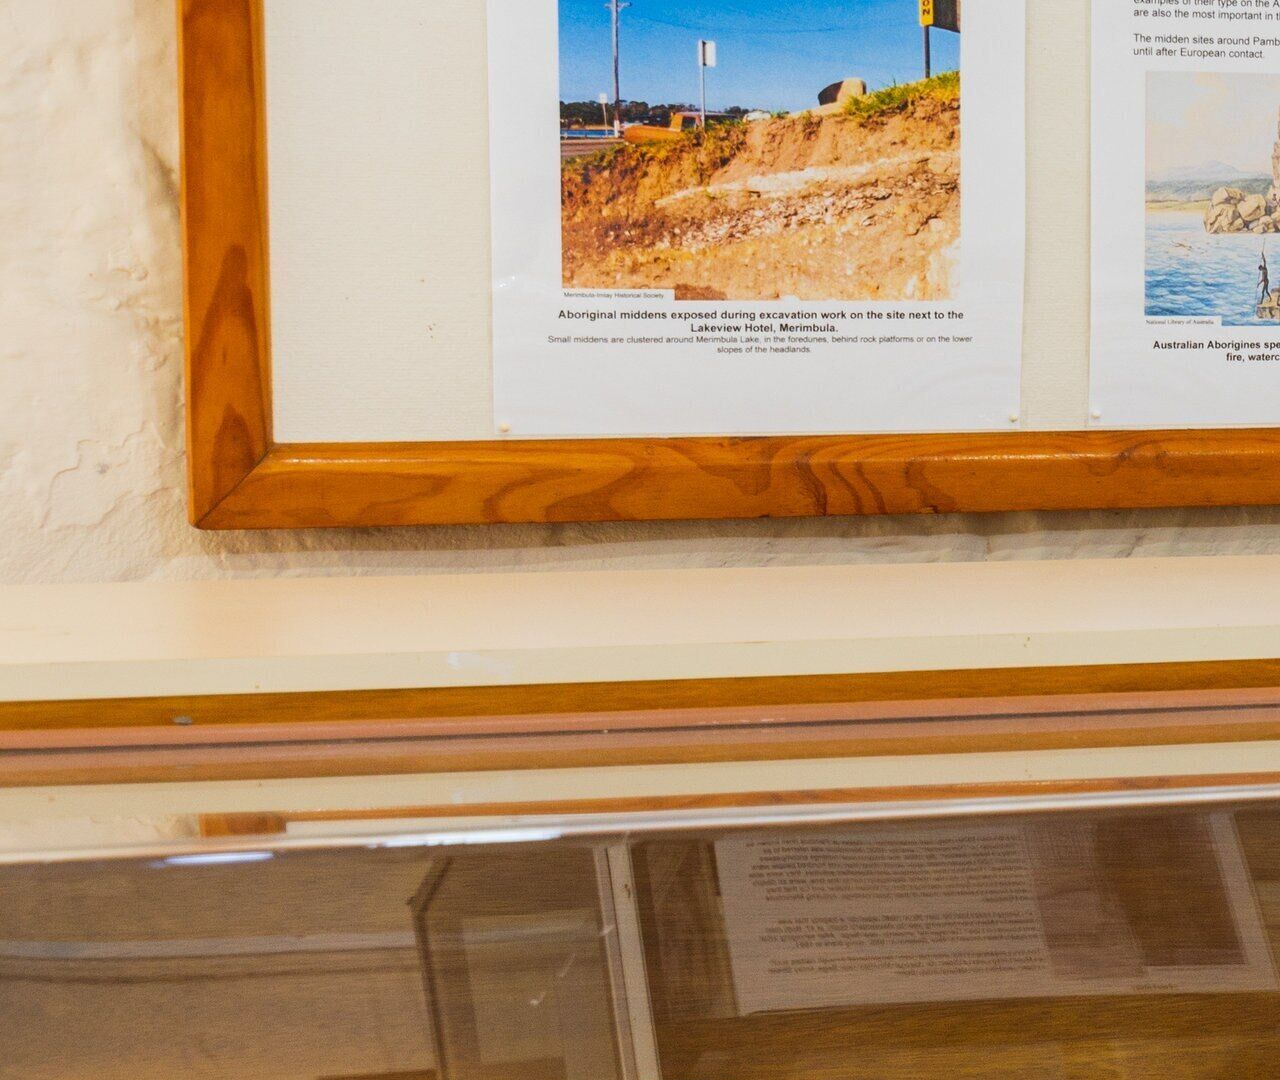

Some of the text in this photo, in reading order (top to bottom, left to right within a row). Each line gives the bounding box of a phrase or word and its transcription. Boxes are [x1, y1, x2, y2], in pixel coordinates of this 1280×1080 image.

[1152, 9, 1171, 17] also
[1174, 9, 1189, 18] the
[1192, 10, 1215, 19] most
[1218, 11, 1261, 21] important
[1264, 11, 1273, 20] in
[1134, 33, 1151, 42] The
[1154, 34, 1189, 43] midden
[1192, 36, 1214, 44] sites
[1217, 36, 1250, 45] around
[1133, 46, 1152, 55] until
[1155, 47, 1176, 56] after
[1180, 47, 1225, 59] European
[558, 310, 616, 321] Aboriginal
[620, 310, 667, 319] middens
[671, 310, 717, 321] exposed
[720, 310, 755, 321] during
[759, 311, 817, 319] excavation
[821, 310, 846, 319] work
[866, 310, 882, 319] the
[886, 310, 905, 319] site
[908, 311, 930, 319] next
[934, 311, 944, 319] to
[947, 310, 963, 319] the
[690, 323, 838, 332] Lakeview Hotel, Merimbula.
[548, 335, 571, 343] Small
[878, 335, 914, 344] platforms
[717, 346, 742, 354] slopes
[745, 345, 753, 353] of
[1153, 340, 1204, 349] Australian
[1207, 340, 1260, 351] Aborigines
[1226, 352, 1245, 362] fire,
